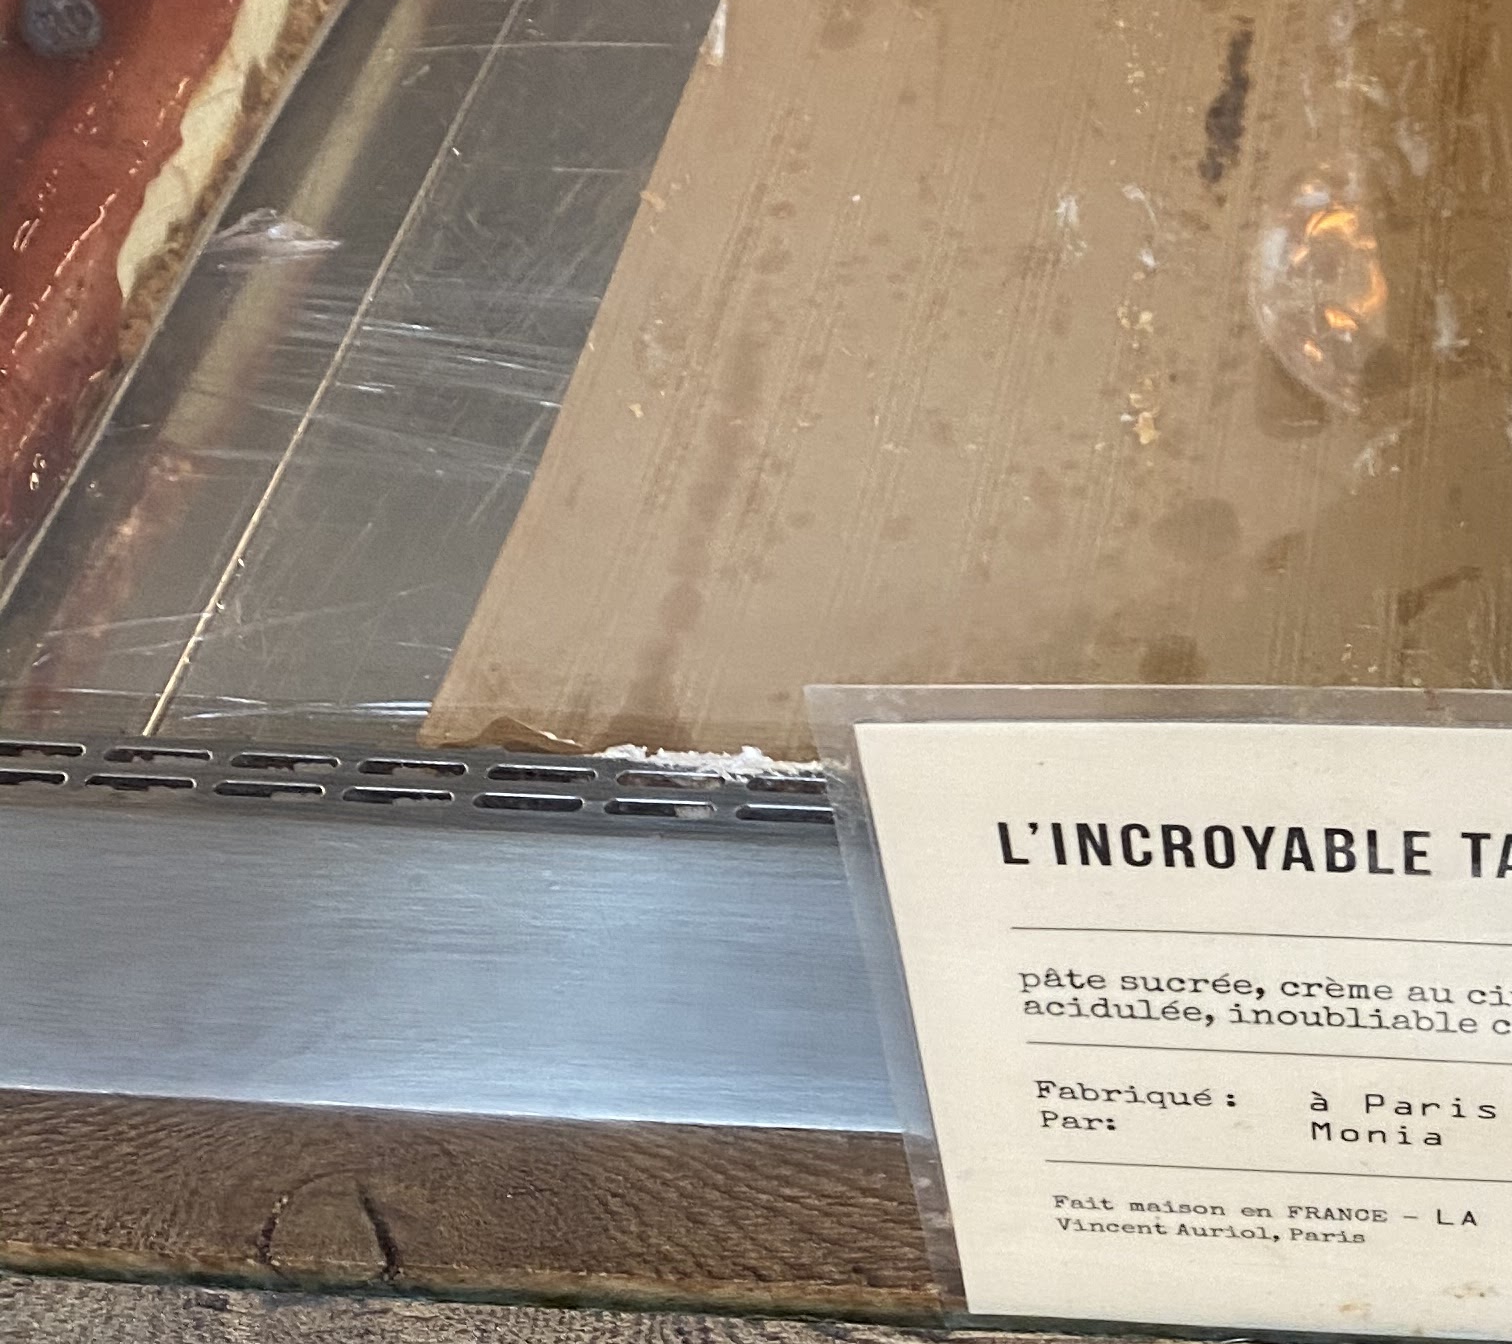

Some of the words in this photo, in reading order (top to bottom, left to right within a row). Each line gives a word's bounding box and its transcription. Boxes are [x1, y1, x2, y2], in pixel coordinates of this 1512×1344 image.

[1019, 967, 1107, 993] pâte
[1120, 972, 1267, 999] sucrée,
[1279, 976, 1393, 1002] crème
[1407, 982, 1452, 1004] au
[1022, 997, 1217, 1027] acidulée,
[1228, 1002, 1479, 1035] inoubliable
[1310, 1090, 1330, 1113] à
[1364, 1093, 1498, 1120] Paris
[1041, 1110, 1117, 1132] Par:
[1311, 1122, 1443, 1147] Monia
[1053, 1195, 1115, 1211] Fait
[1129, 1198, 1226, 1216] maison
[1240, 1207, 1273, 1218] en
[1287, 1206, 1389, 1223] FRANCE
[1436, 1208, 1479, 1228] LA
[1055, 1217, 1169, 1236] Vincent
[1176, 1223, 1281, 1243] Auriol,
[1289, 1228, 1366, 1244] Paris
